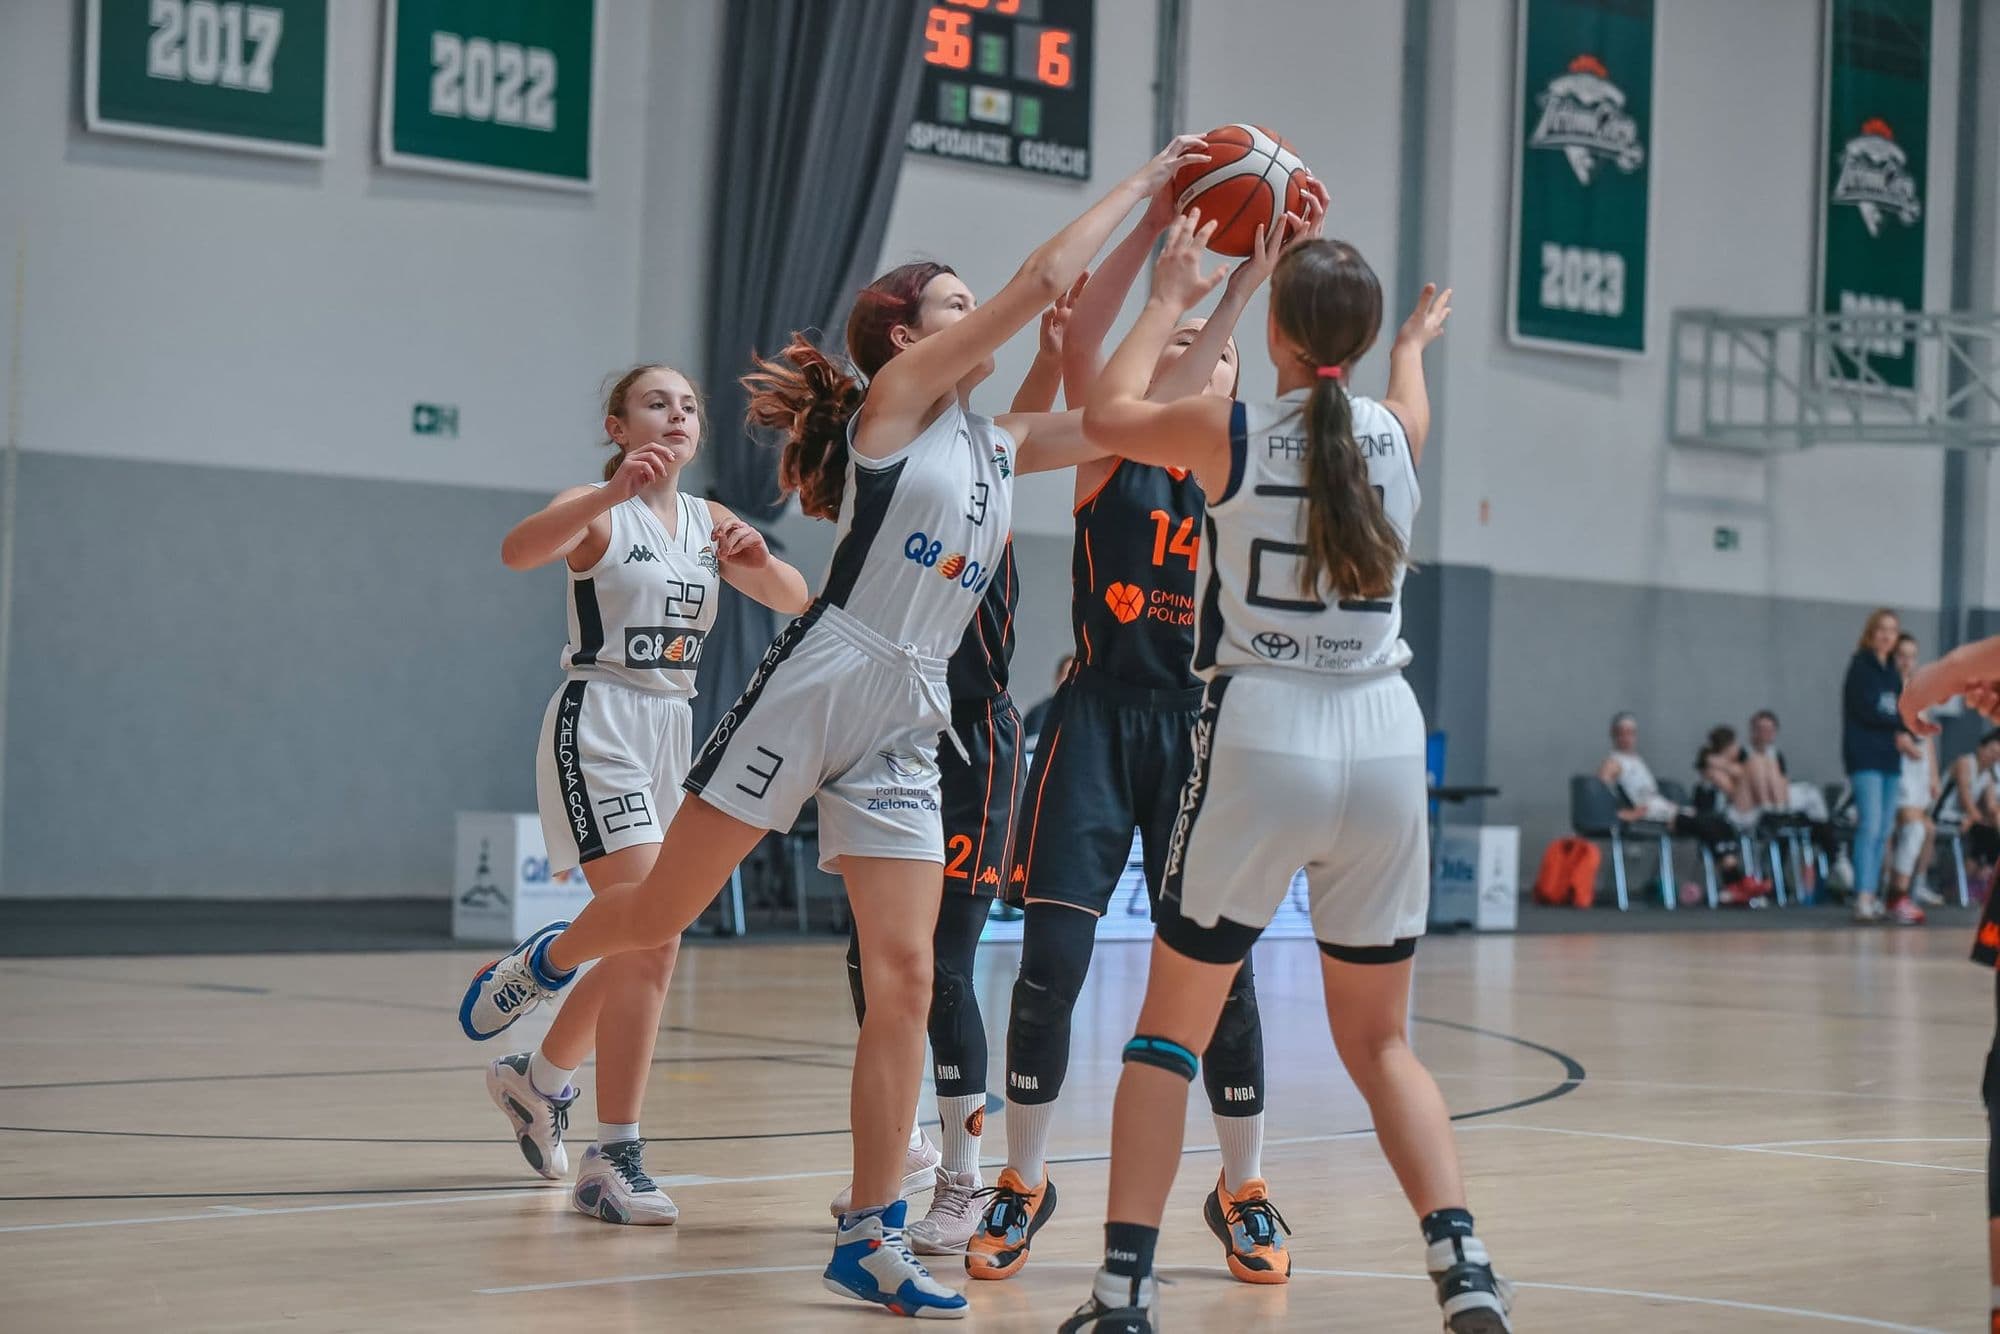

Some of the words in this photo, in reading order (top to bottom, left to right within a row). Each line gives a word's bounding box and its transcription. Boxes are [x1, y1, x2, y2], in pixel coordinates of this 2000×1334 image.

[147, 0, 283, 94] 2017
[1038, 29, 1071, 88] 6
[430, 31, 558, 132] 2022
[1539, 242, 1626, 318] 2023
[904, 531, 943, 568] Q8
[1151, 509, 1200, 572] 14
[666, 579, 706, 620] 29
[628, 633, 665, 662] Q8
[1314, 635, 1363, 654] Toyota
[559, 715, 579, 792] ZIELONA
[735, 744, 785, 799] 3
[597, 790, 653, 835] 29
[867, 798, 919, 811] Zielona
[876, 786, 897, 797] Port
[944, 834, 973, 879] 2
[942, 1064, 962, 1081] NBA
[1017, 1073, 1039, 1090] NBA
[1233, 1085, 1256, 1101] NBA
